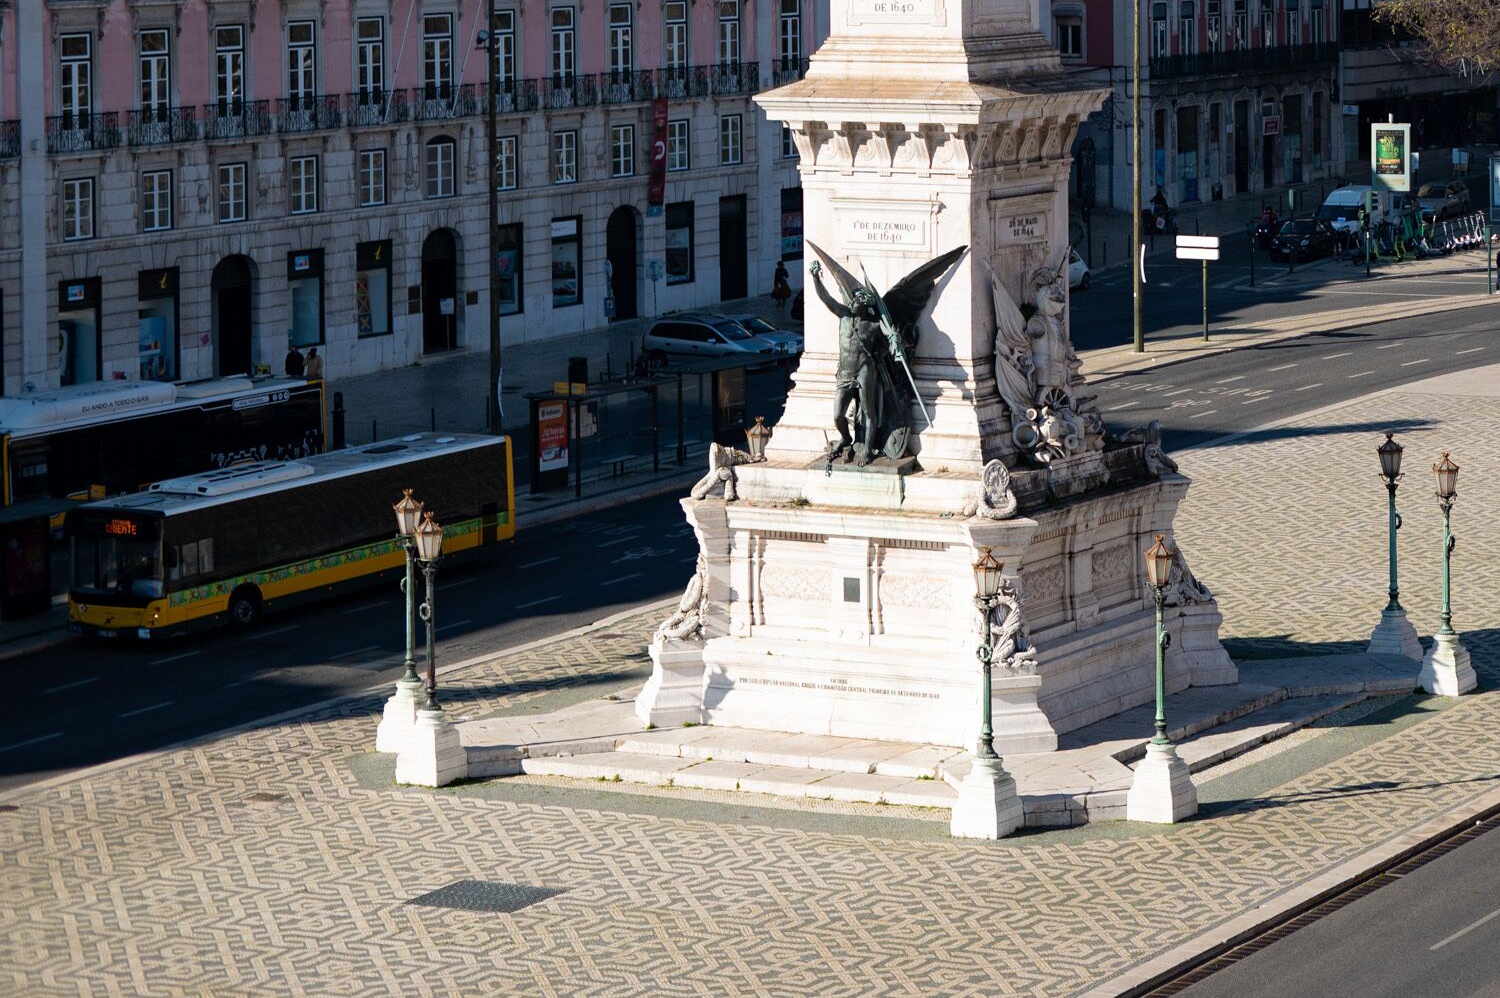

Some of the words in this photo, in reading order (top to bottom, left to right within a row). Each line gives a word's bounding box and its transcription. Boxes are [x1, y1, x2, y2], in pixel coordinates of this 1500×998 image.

[874, 3, 887, 12] DE
[890, 1, 915, 14] 1640
[1017, 218, 1024, 227] DE
[1025, 216, 1038, 226] MAIO
[860, 222, 871, 230] DE
[872, 222, 916, 232] DEZEMBRO
[1013, 228, 1020, 236] DE
[867, 233, 879, 241] DE
[880, 232, 902, 243] 1640
[1101, 382, 1175, 392] BUS
[1198, 387, 1274, 397] BUS
[82, 405, 91, 413] EU
[91, 402, 108, 410] ANDO
[114, 398, 130, 407] TODO
[105, 523, 137, 535] ORIENTE
[779, 680, 800, 688] NACIONAL
